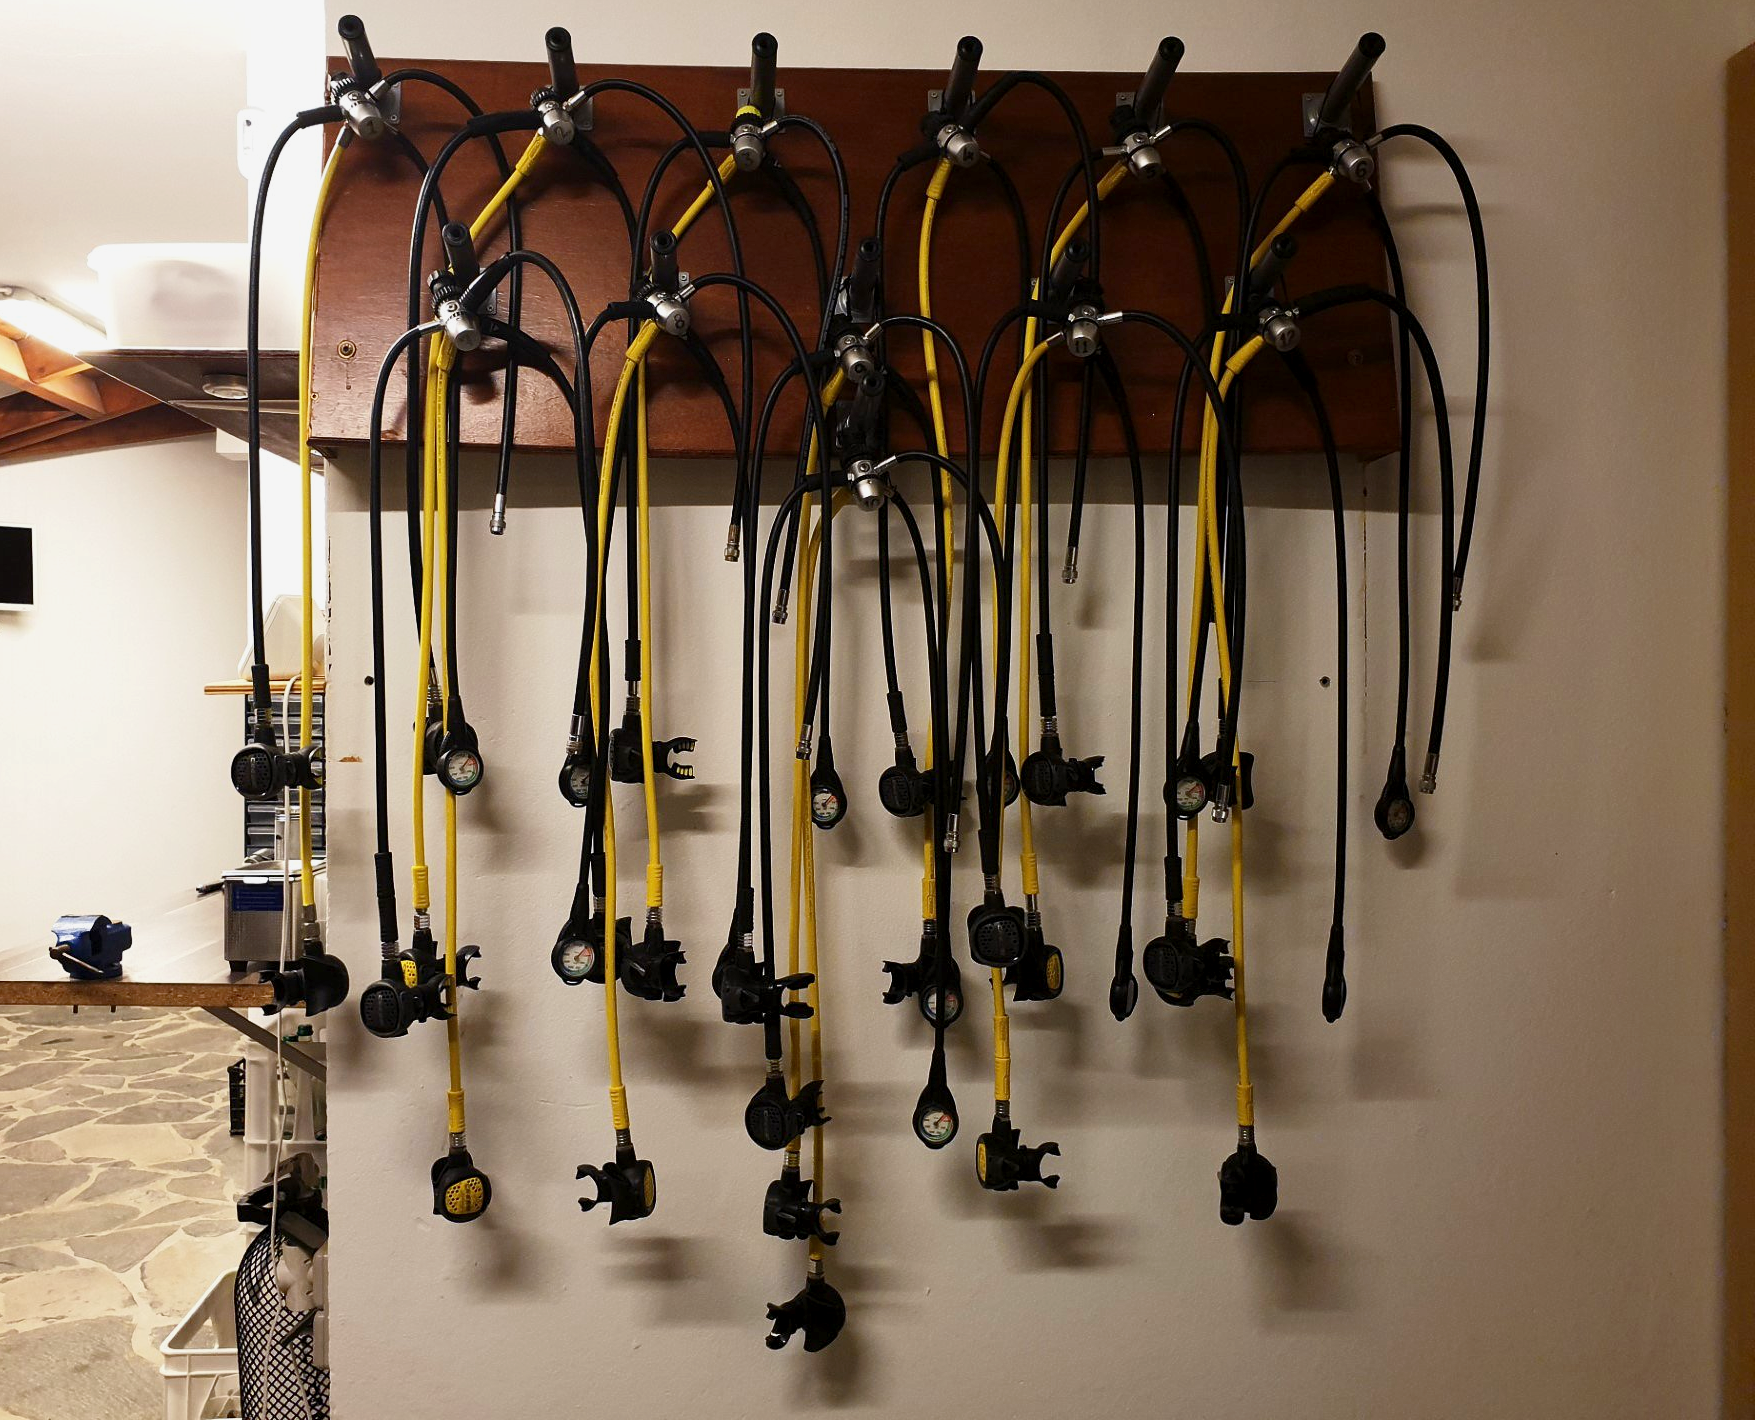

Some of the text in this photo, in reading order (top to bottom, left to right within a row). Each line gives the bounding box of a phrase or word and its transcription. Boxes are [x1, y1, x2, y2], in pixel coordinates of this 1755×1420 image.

[366, 119, 377, 134] 1
[742, 152, 754, 166] 3
[962, 147, 974, 161] 4
[1146, 165, 1156, 179] 5
[1354, 160, 1367, 178] 6
[674, 313, 685, 329] 8
[1075, 340, 1088, 353] 11
